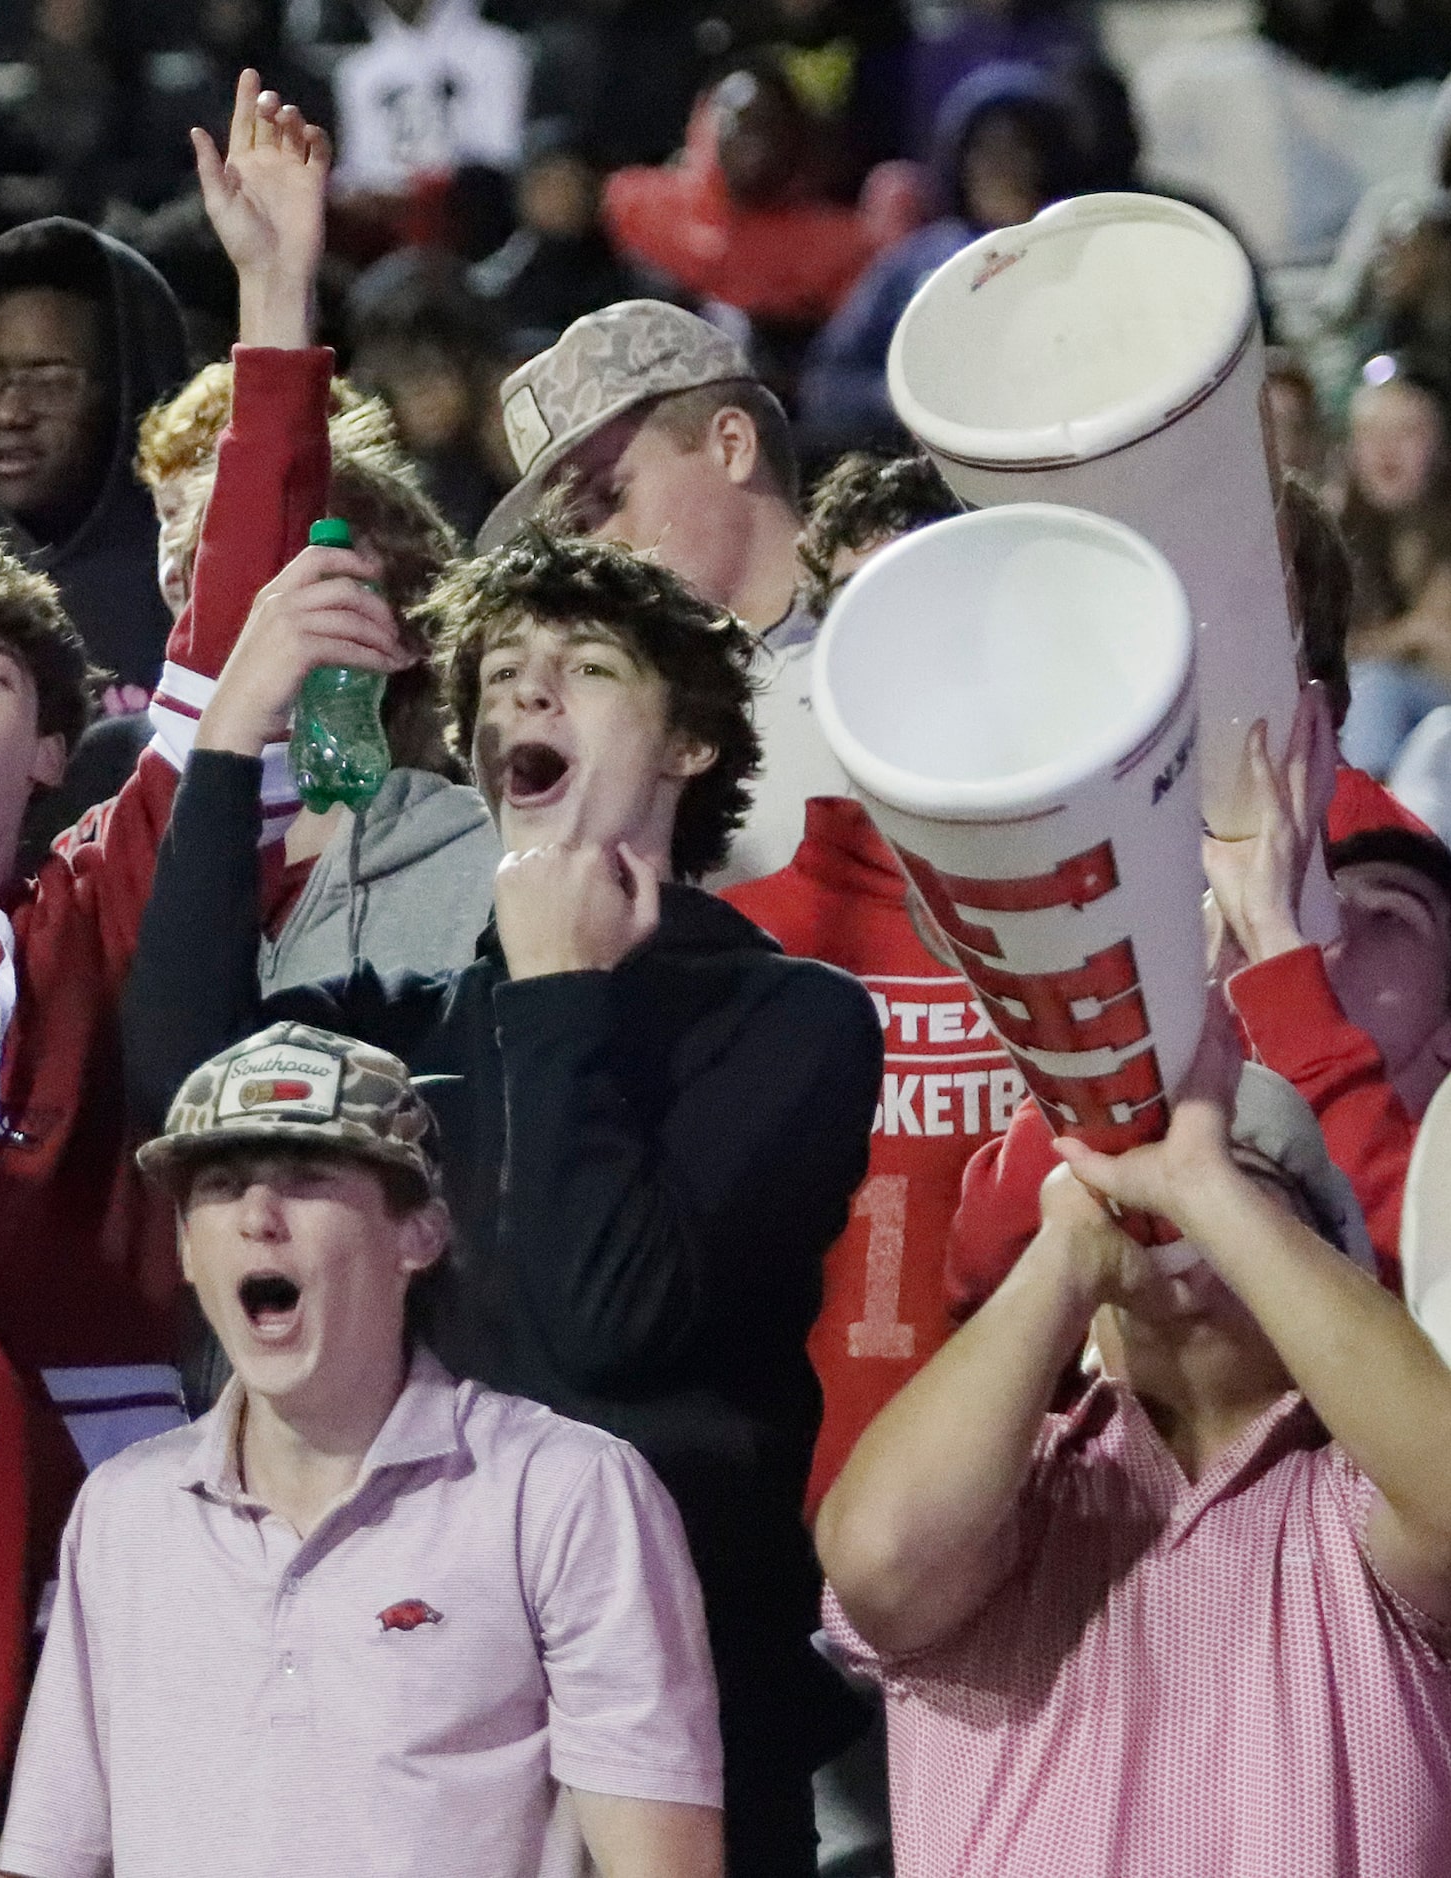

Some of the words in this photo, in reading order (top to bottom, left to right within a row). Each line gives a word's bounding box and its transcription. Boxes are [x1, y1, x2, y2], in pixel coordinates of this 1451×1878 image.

[230, 1051, 333, 1080] Southpaw
[886, 838, 1186, 1248] LHH
[871, 1067, 1028, 1137] KETB
